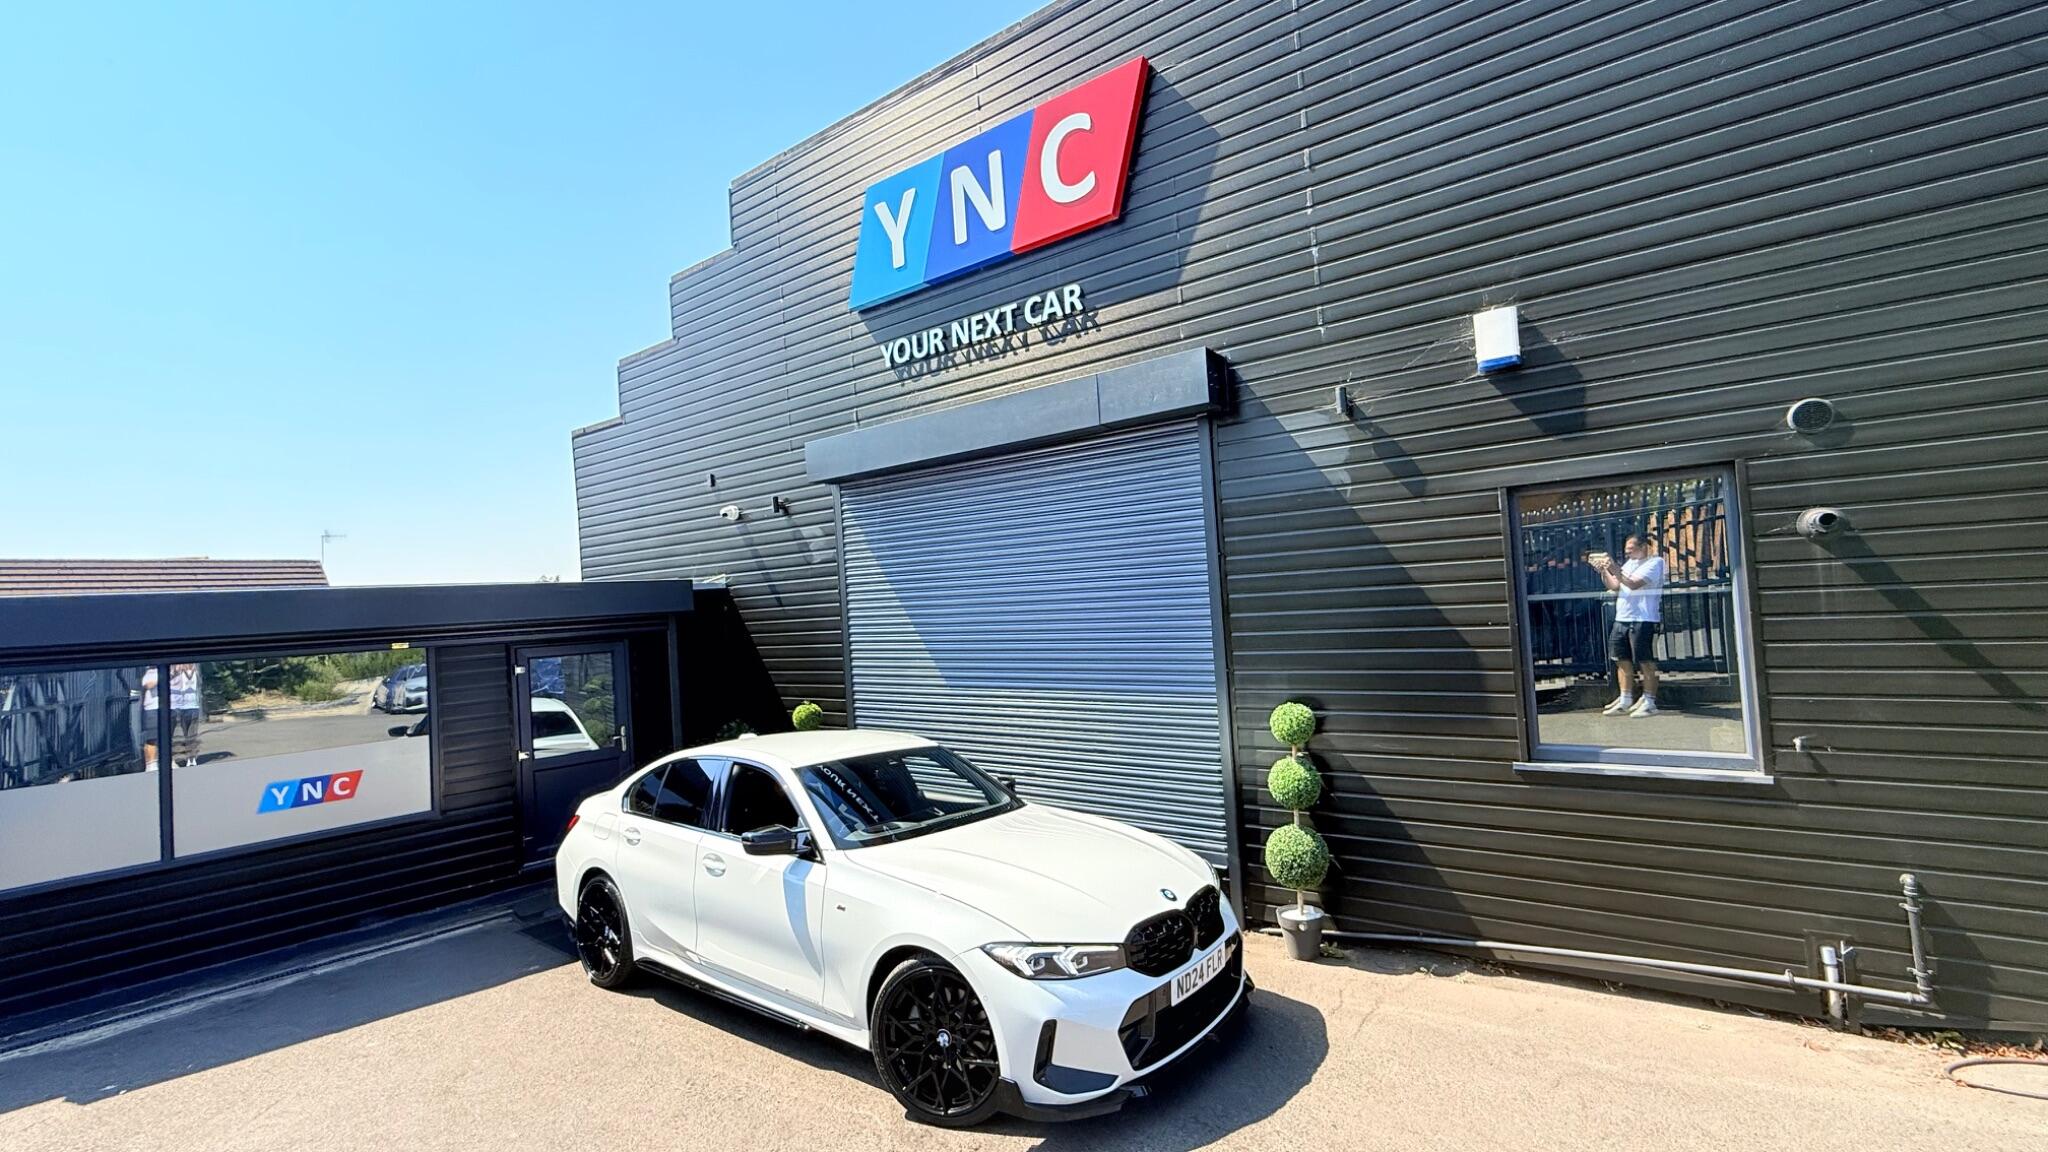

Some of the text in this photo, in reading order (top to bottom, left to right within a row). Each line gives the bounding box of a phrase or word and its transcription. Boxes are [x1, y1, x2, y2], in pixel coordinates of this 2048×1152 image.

[874, 112, 1096, 270] YNC
[880, 284, 1084, 368] YOUR NEXT CAR
[271, 777, 351, 805] YNC
[1176, 949, 1224, 999] ND24 FLR
